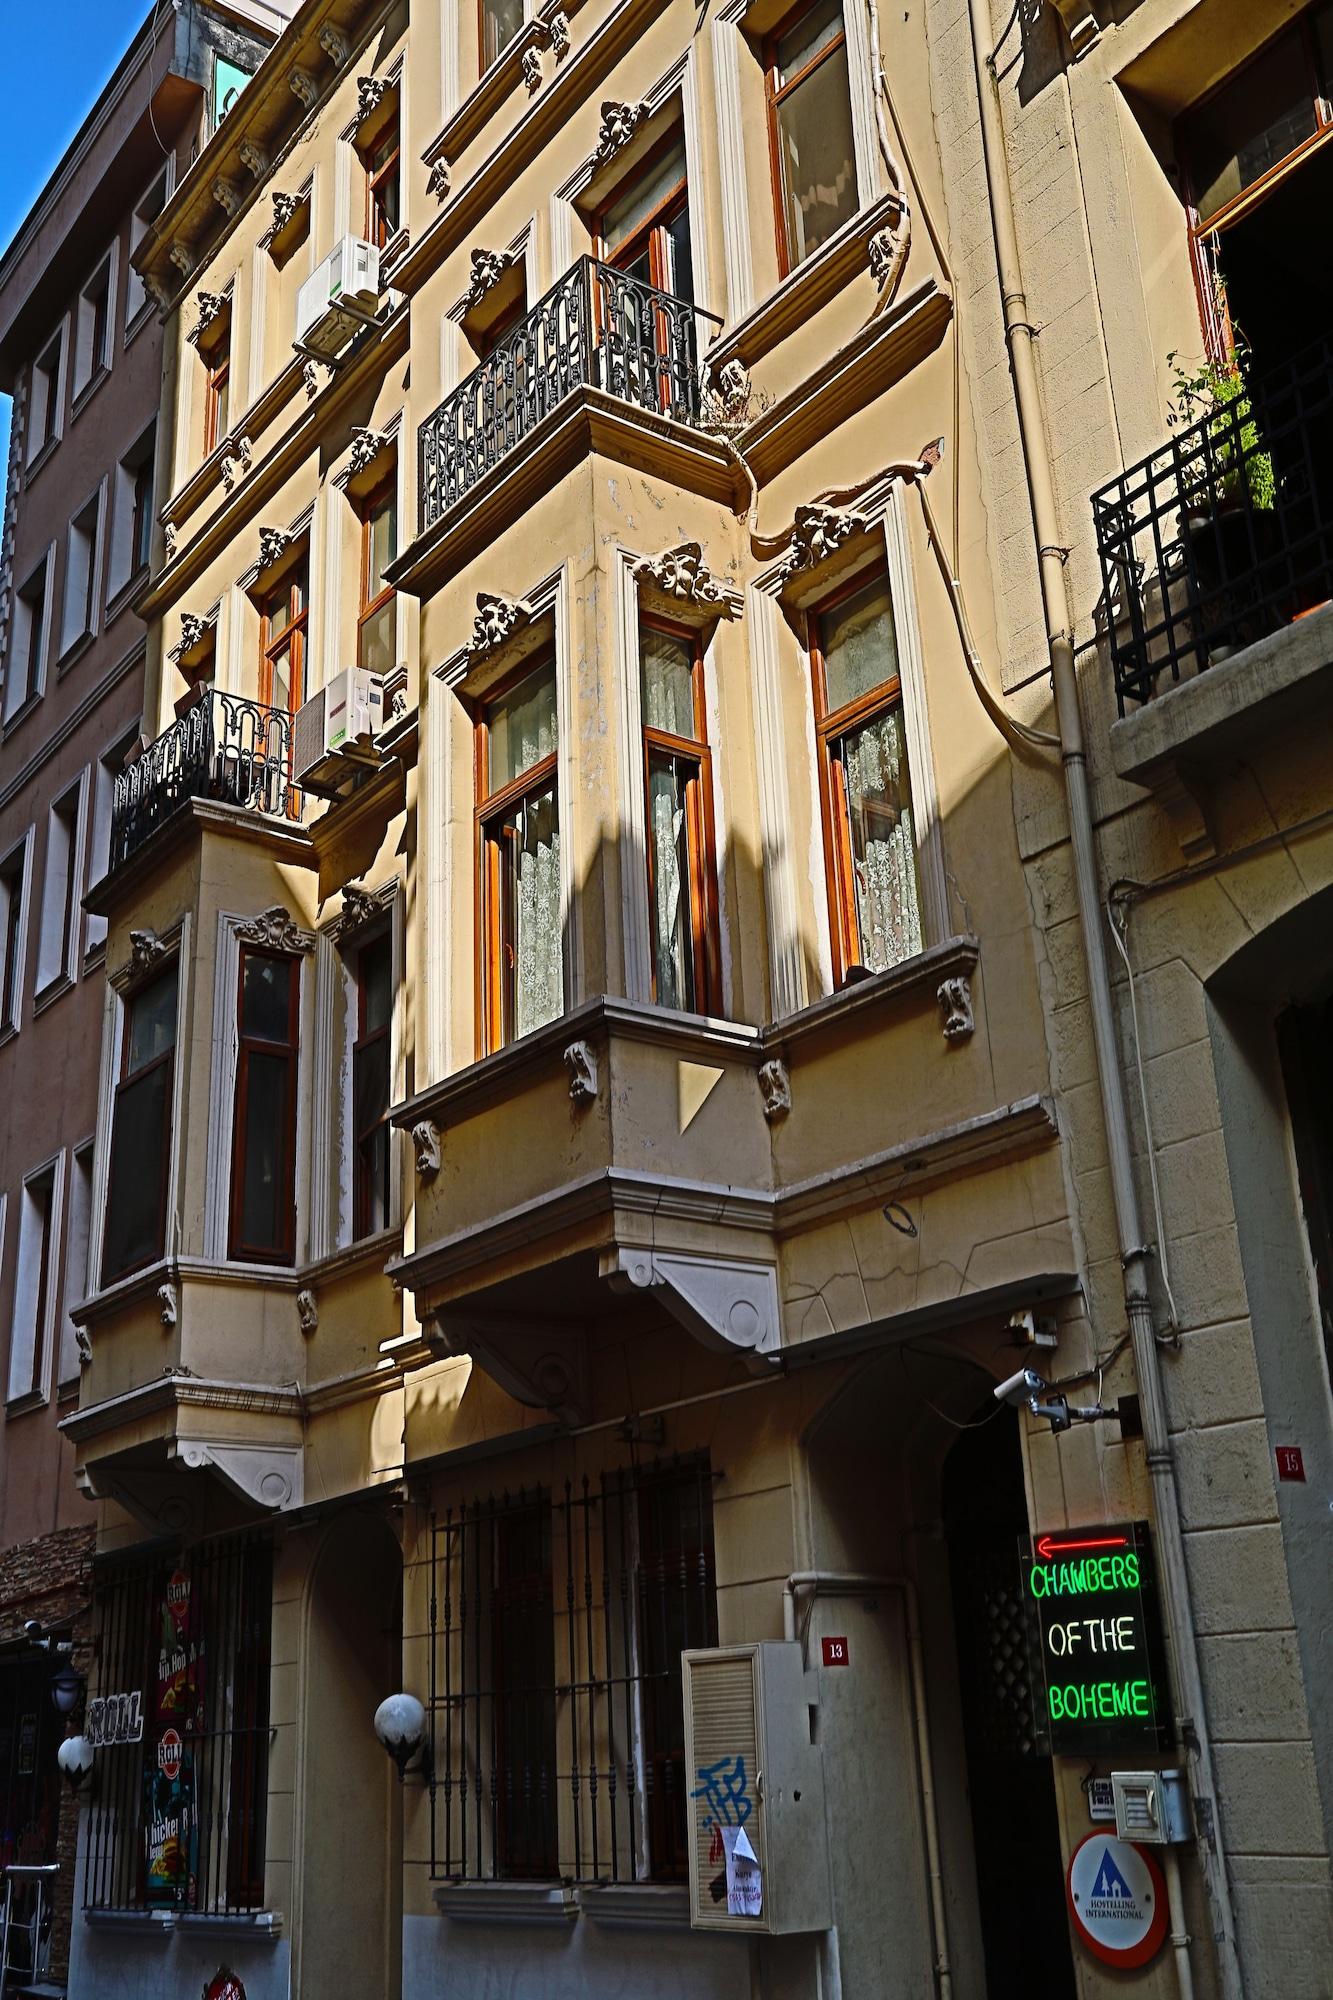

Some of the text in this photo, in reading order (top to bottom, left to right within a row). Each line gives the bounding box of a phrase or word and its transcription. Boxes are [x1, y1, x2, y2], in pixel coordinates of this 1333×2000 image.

[1284, 1453, 1299, 1471] 15
[1030, 1553, 1140, 1599] CHAMBERS
[1049, 1616, 1136, 1657] OF THE
[829, 1644, 844, 1659] 13
[1049, 1680, 1149, 1720] BOHEME
[86, 1691, 144, 1747] ROLL
[1085, 1909, 1144, 1920] INTERNATIONAL
[1090, 1899, 1136, 1910] HOSTELLING
